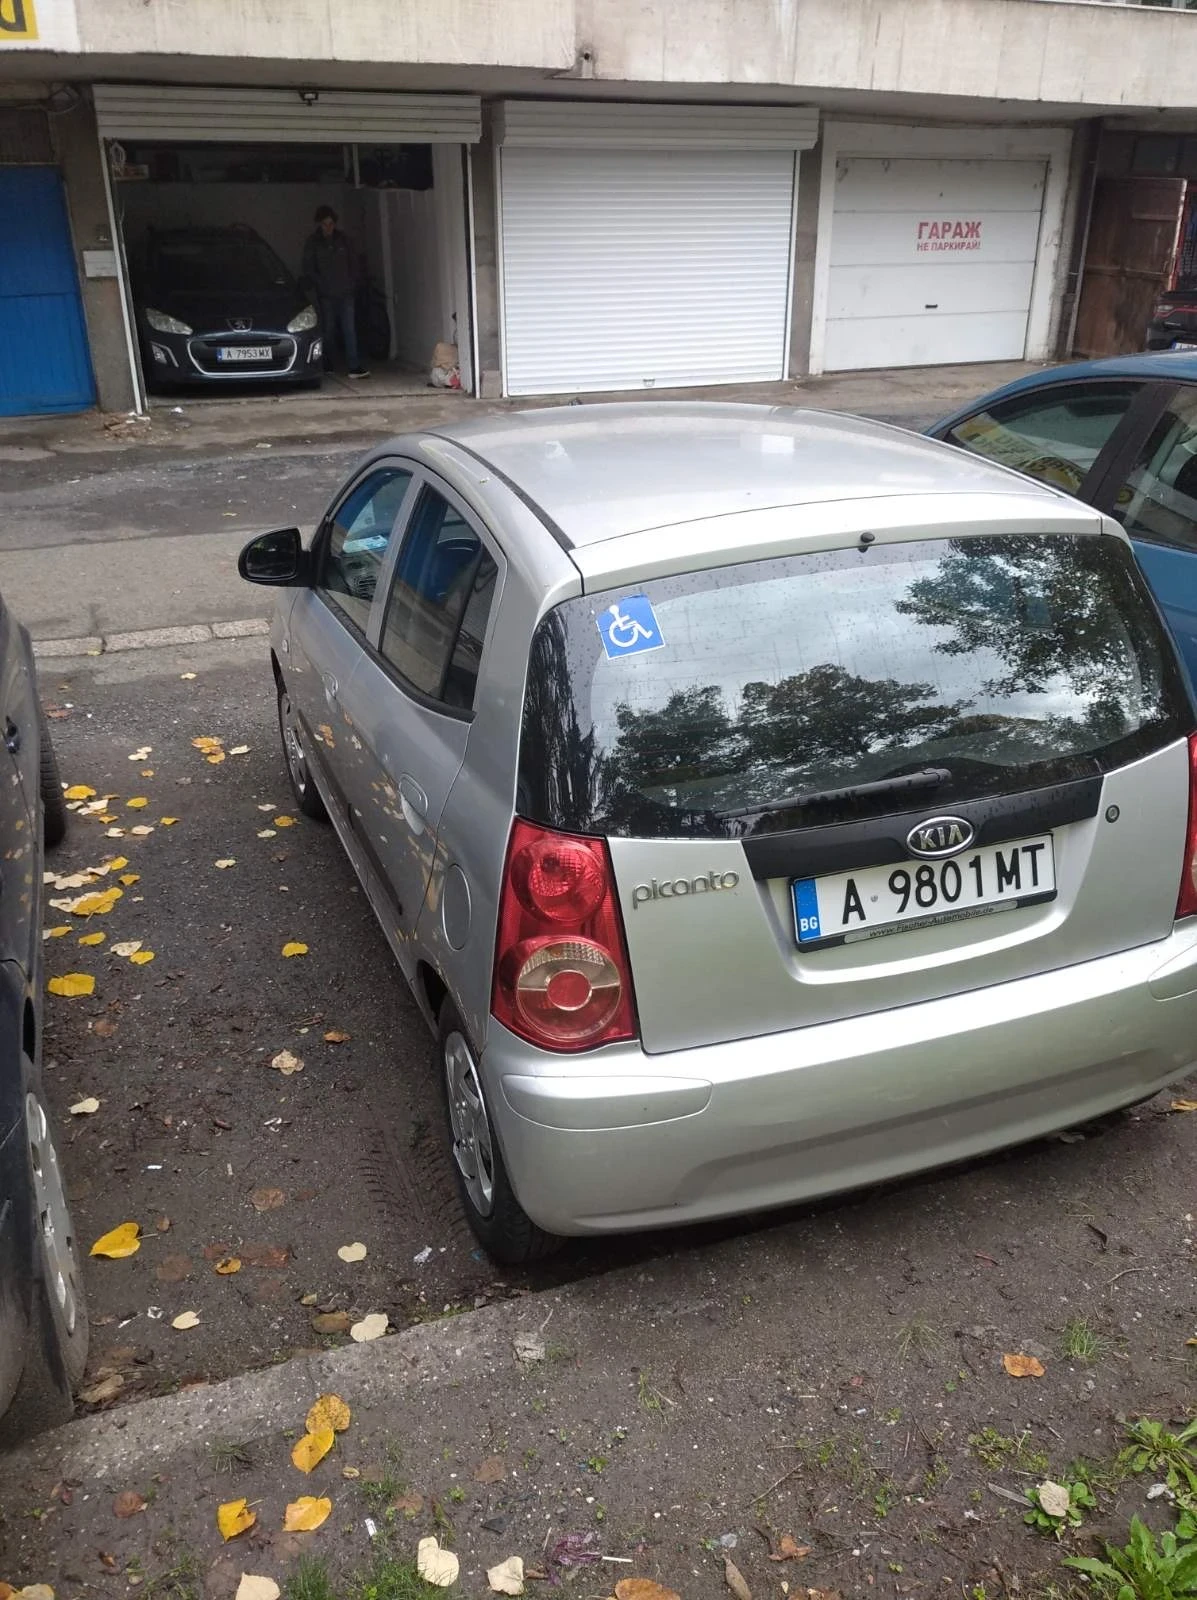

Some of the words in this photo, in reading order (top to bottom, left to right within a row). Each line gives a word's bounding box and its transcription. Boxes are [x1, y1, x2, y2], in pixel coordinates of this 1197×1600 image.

[918, 221, 982, 239] ГАРАЖ
[917, 242, 929, 251] НЕ
[226, 348, 233, 359] A
[917, 823, 964, 851] KIA
[632, 869, 740, 910] picanto
[842, 878, 867, 925] A
[888, 854, 983, 914] 9801
[995, 843, 1045, 894] MT
[800, 914, 818, 932] BG
